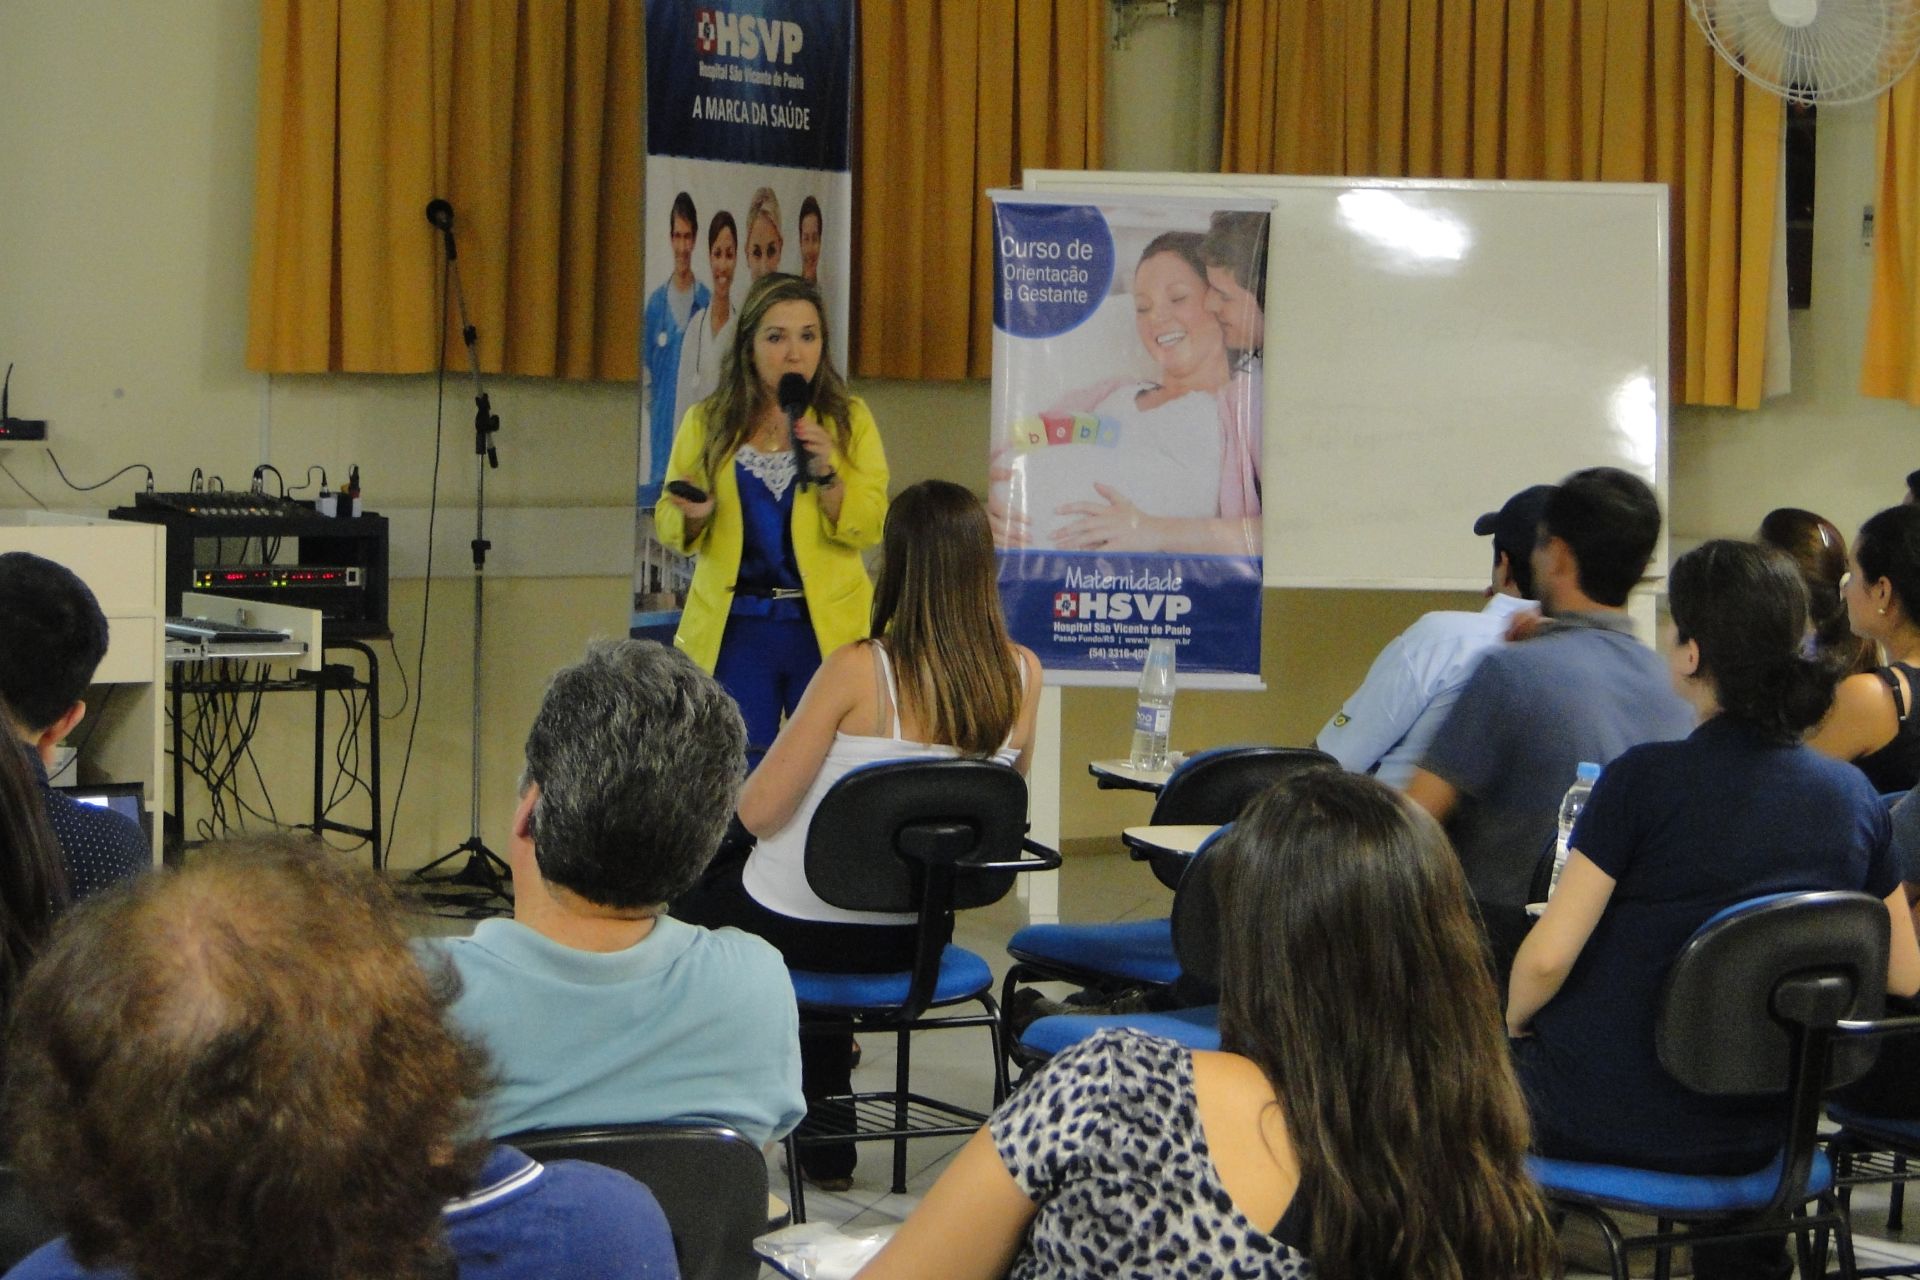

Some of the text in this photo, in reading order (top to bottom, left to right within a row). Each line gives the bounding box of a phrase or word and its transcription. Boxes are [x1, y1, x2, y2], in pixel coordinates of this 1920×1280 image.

[715, 11, 804, 65] HSVP
[692, 95, 810, 131] A MARCA DA SAÚDE
[1001, 236, 1093, 261] Curso de
[1004, 264, 1088, 286] Orientação
[1018, 284, 1088, 304] Gestante
[1065, 566, 1182, 591] Maternidade
[1079, 592, 1192, 621] HSVP
[1053, 622, 1191, 636] Hospital São Vicente de Paulo
